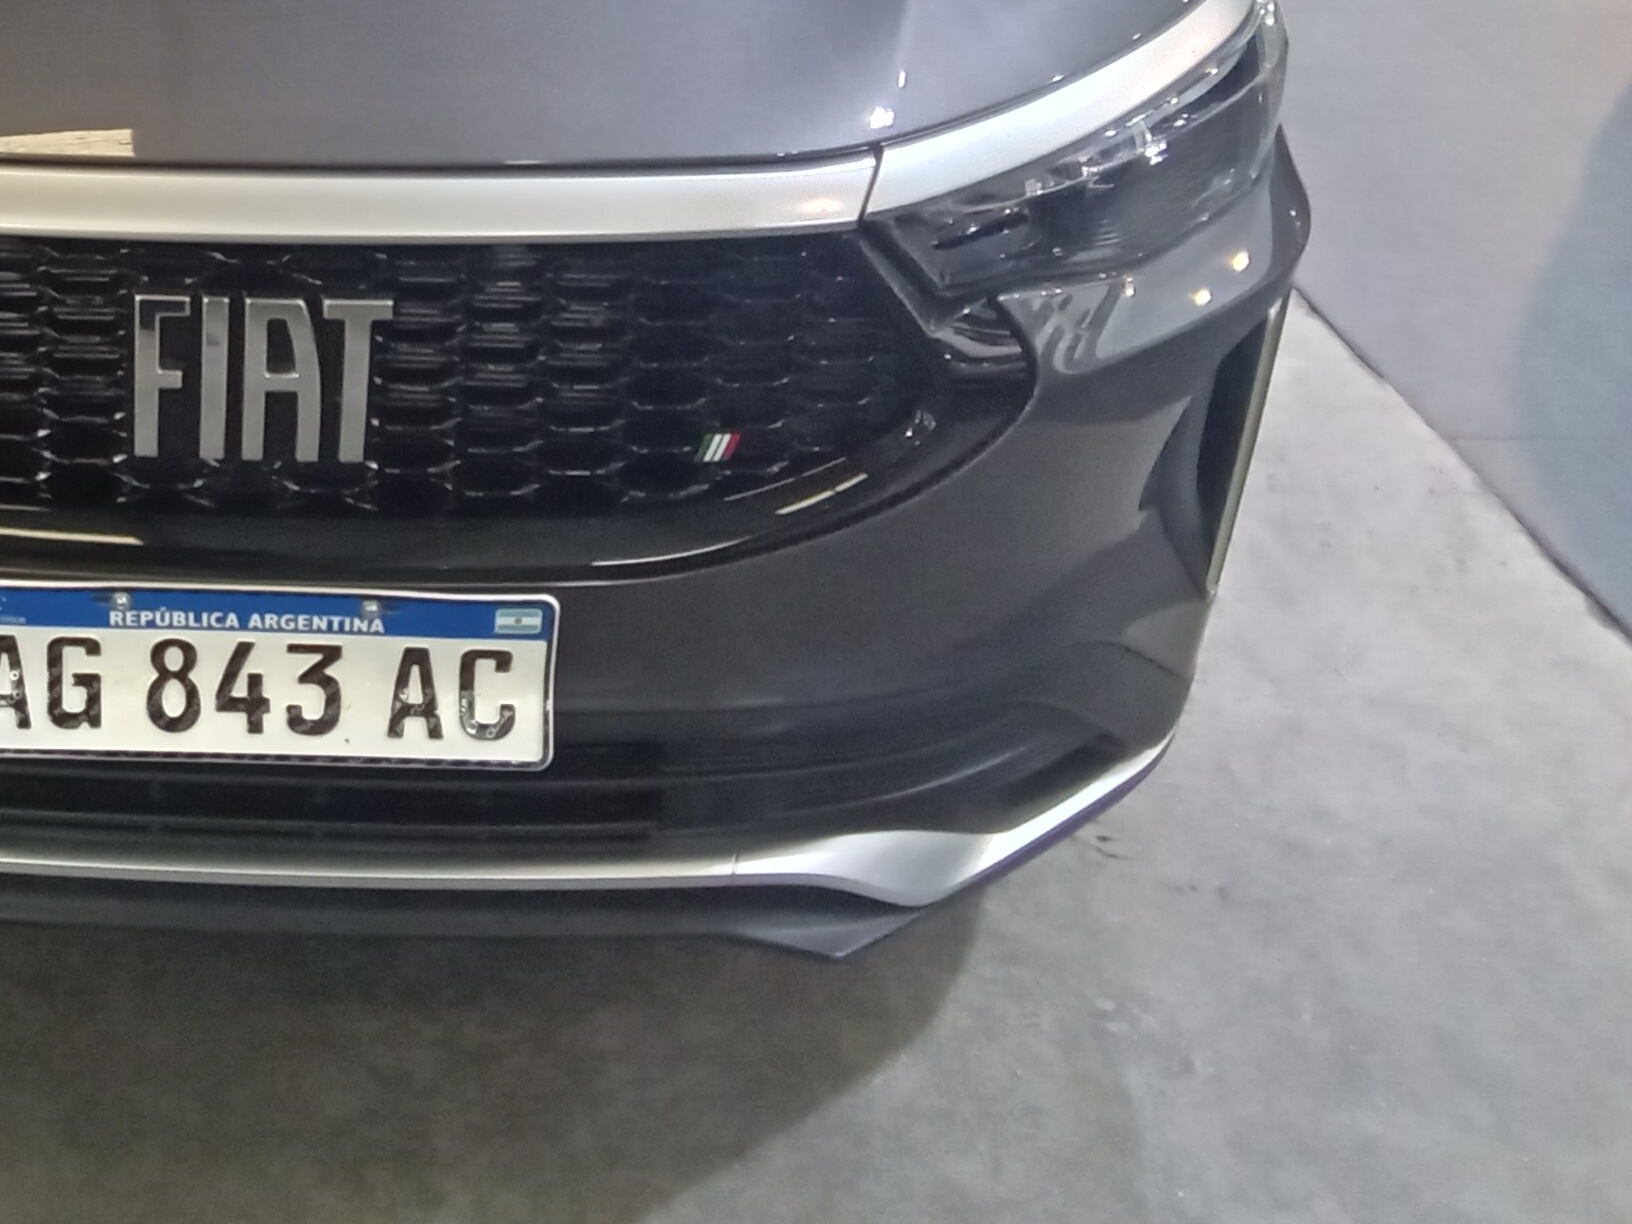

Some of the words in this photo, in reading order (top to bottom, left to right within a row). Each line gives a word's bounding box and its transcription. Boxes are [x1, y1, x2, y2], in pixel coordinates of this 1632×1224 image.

[134, 294, 394, 463] FIAT
[109, 606, 240, 628] REPÚBLICA
[247, 612, 386, 633] ARGENTINA
[146, 638, 343, 736] 843
[387, 647, 515, 741] AC
